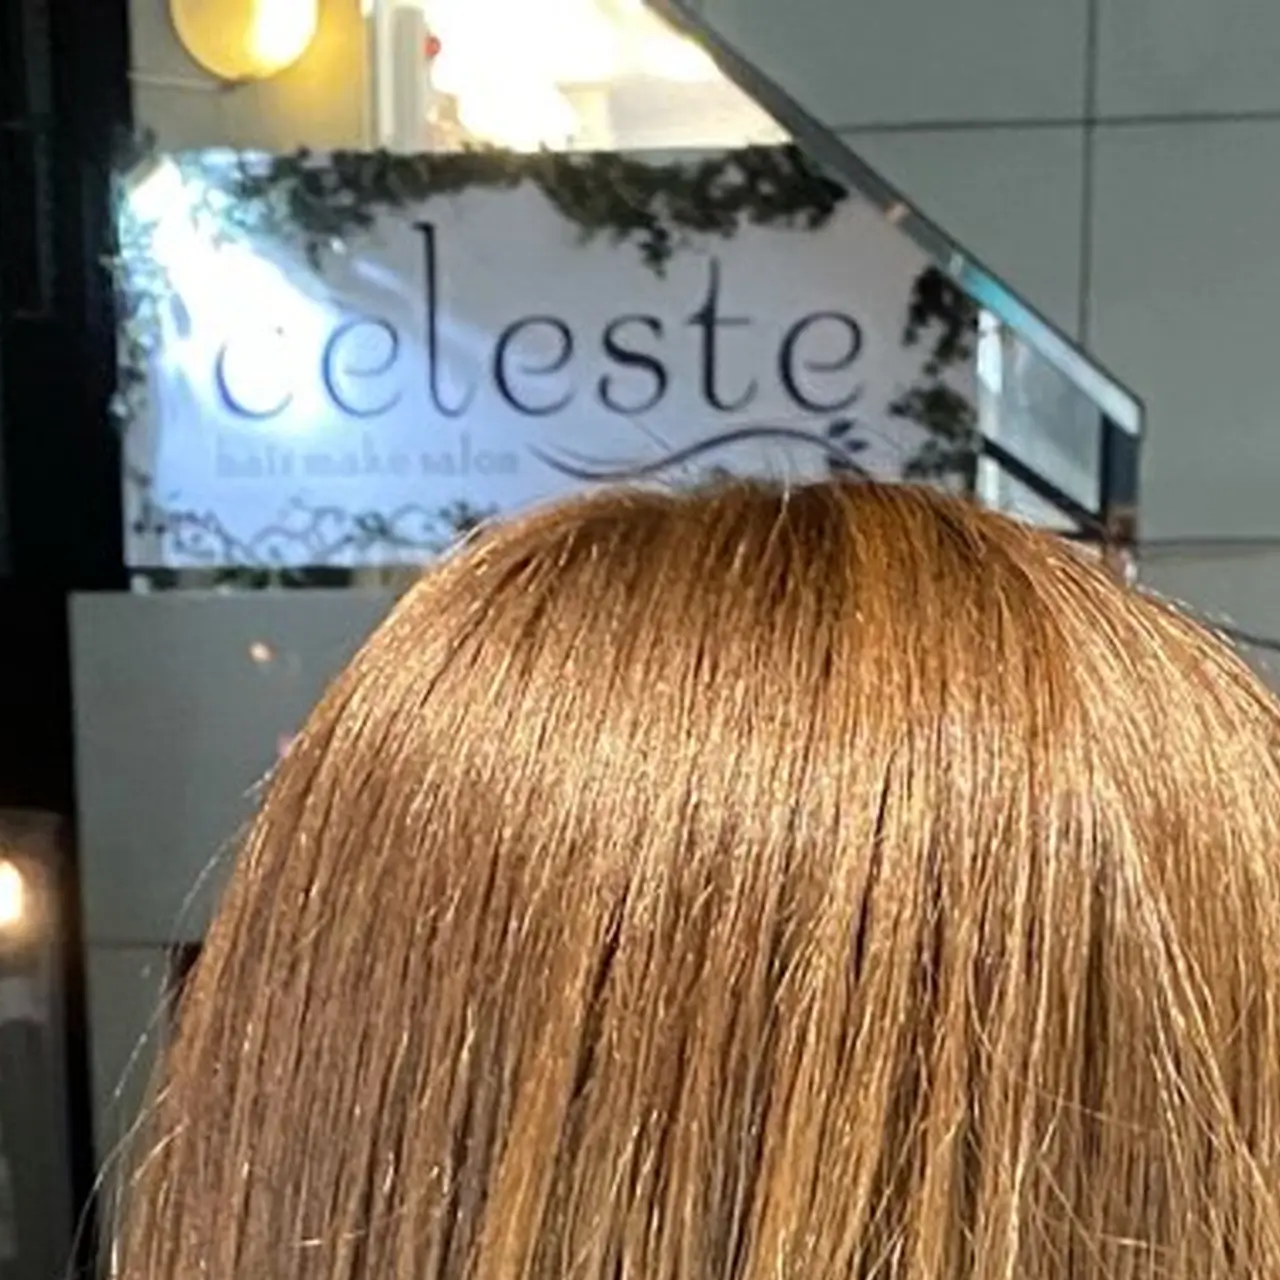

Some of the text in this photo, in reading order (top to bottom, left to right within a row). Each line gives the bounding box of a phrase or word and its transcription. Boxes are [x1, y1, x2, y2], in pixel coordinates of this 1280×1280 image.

[215, 431, 520, 477] hair make salon
